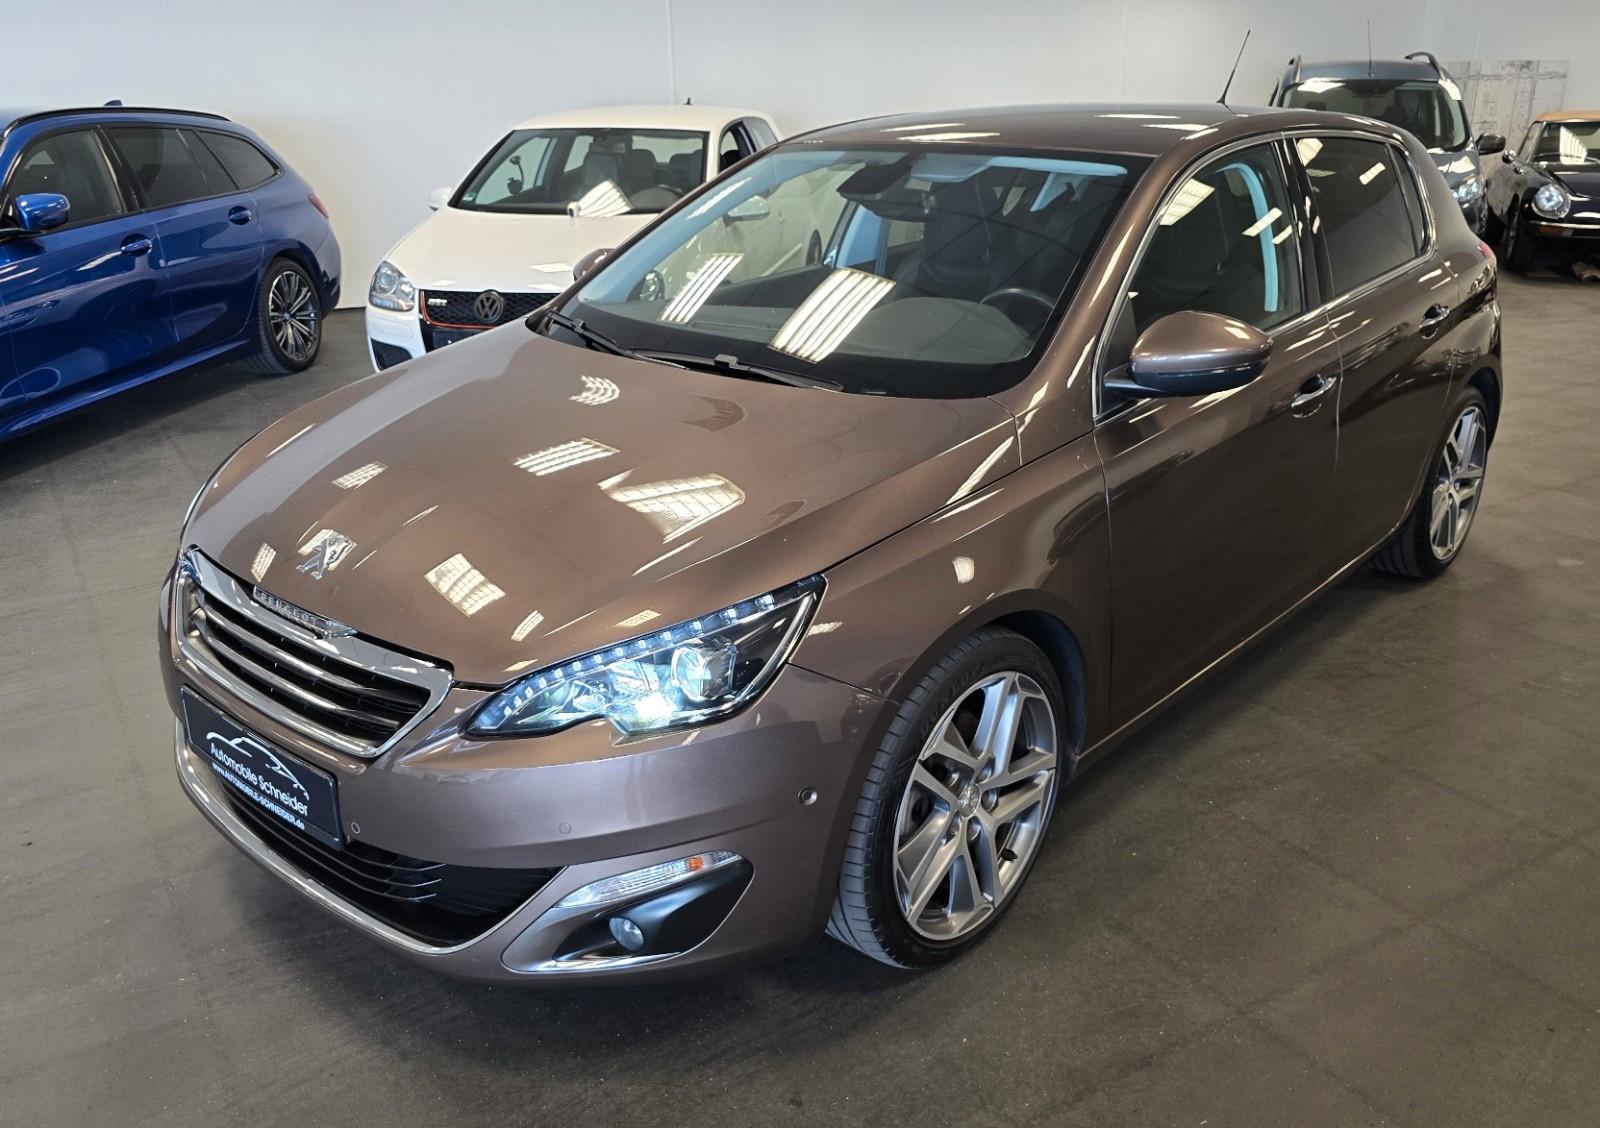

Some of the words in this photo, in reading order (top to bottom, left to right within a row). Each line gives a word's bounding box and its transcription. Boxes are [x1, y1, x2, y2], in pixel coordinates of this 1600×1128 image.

[261, 592, 317, 626] PEUGEOT
[210, 742, 258, 785] Automobile
[258, 775, 308, 816] Schneider
